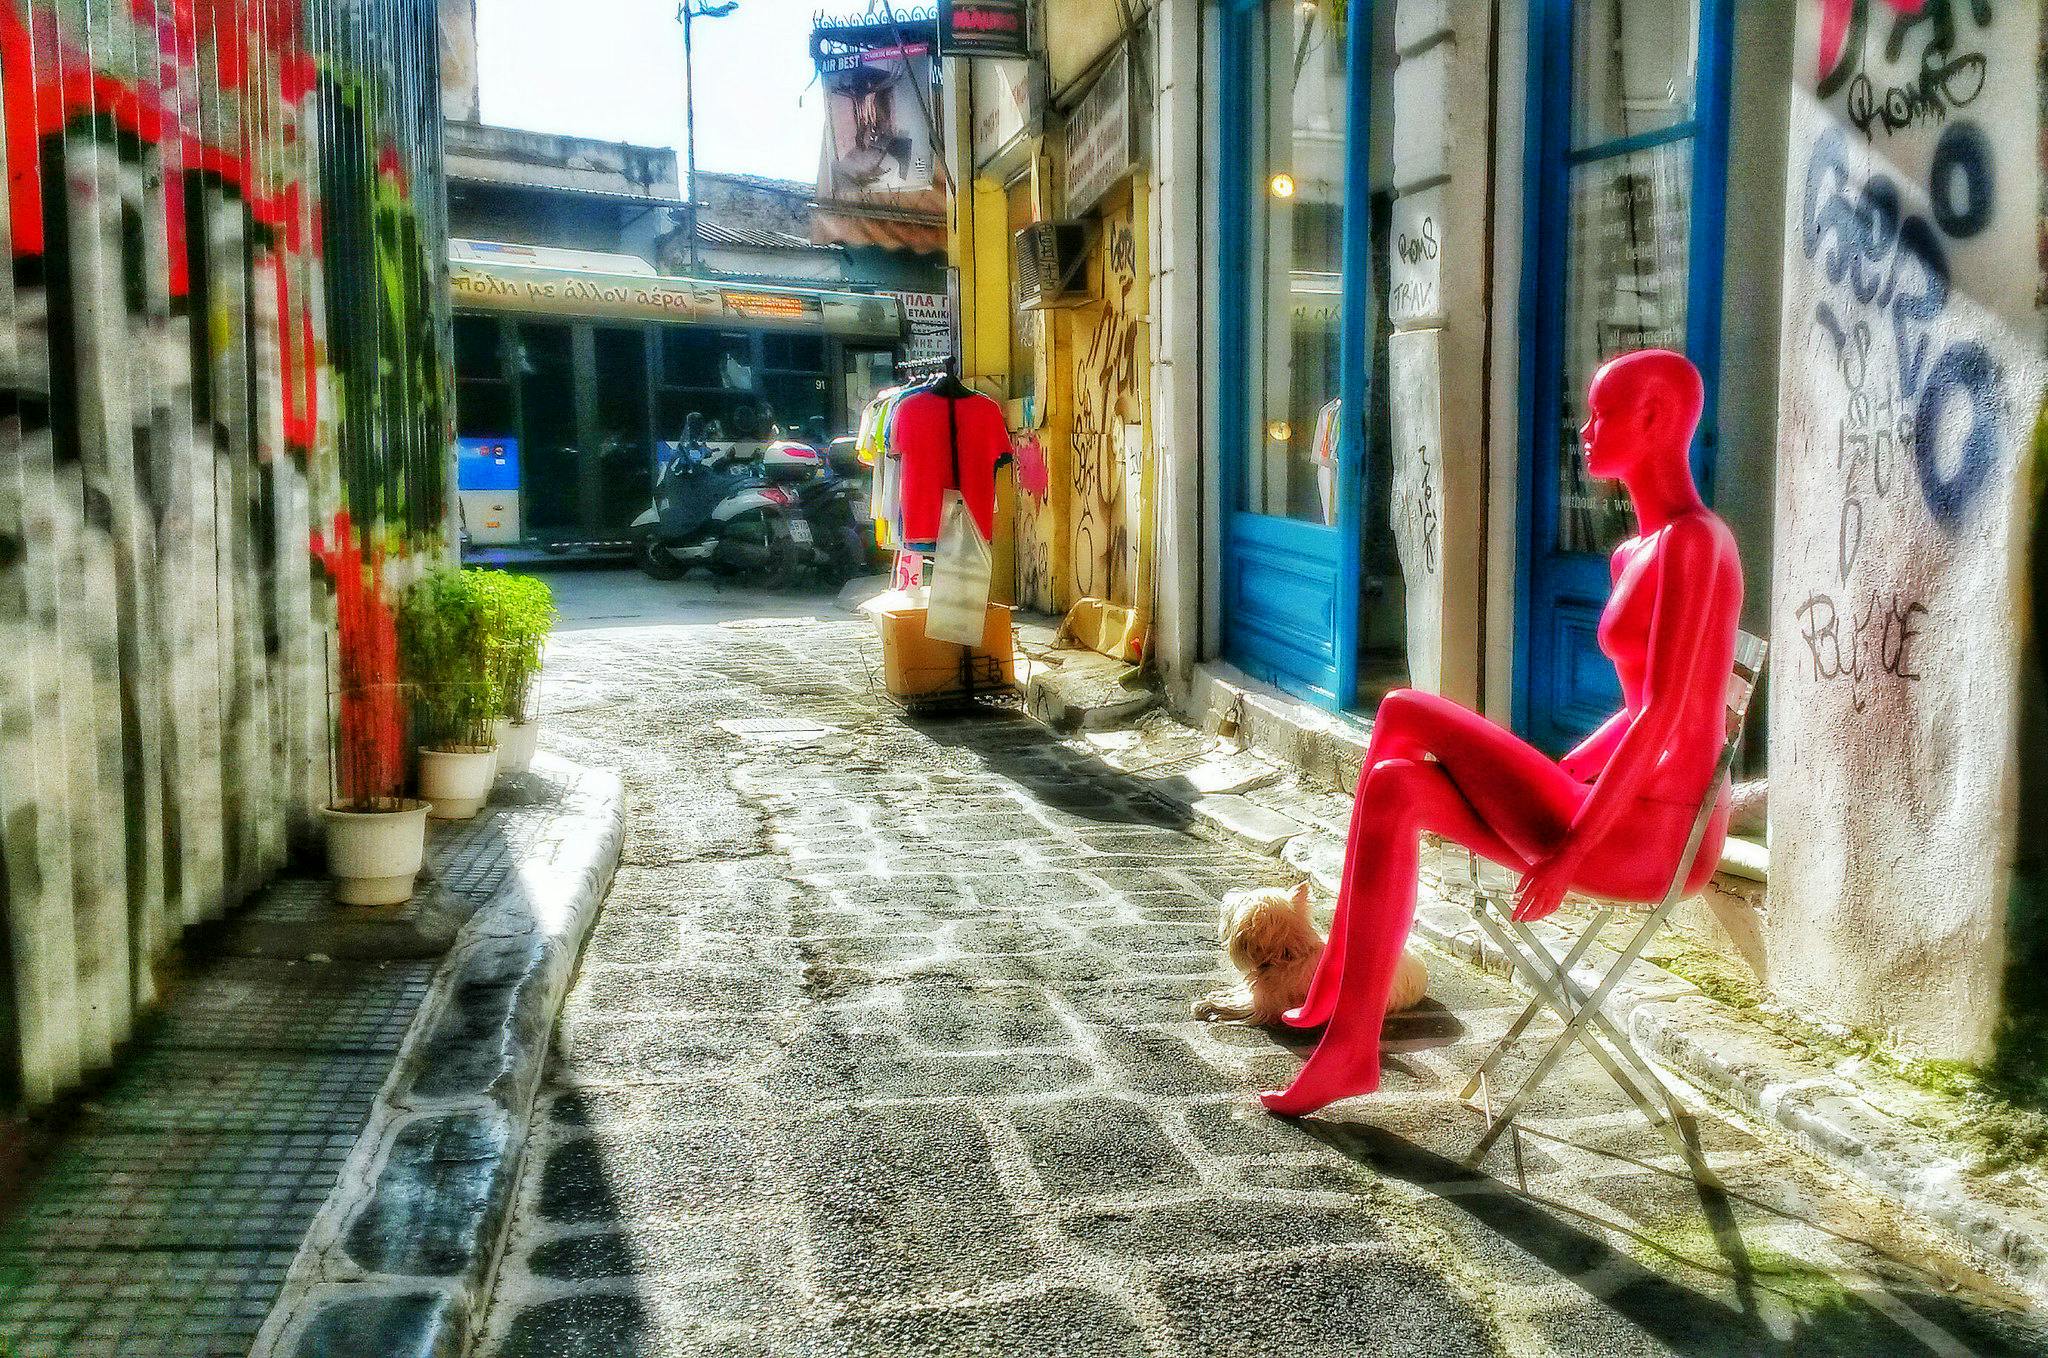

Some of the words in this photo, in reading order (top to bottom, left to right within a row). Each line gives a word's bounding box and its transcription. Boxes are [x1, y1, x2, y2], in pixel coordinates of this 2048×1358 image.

[838, 55, 861, 71] BEST
[526, 282, 555, 304] με
[637, 287, 687, 309] αέρα
[815, 379, 826, 390] 91
